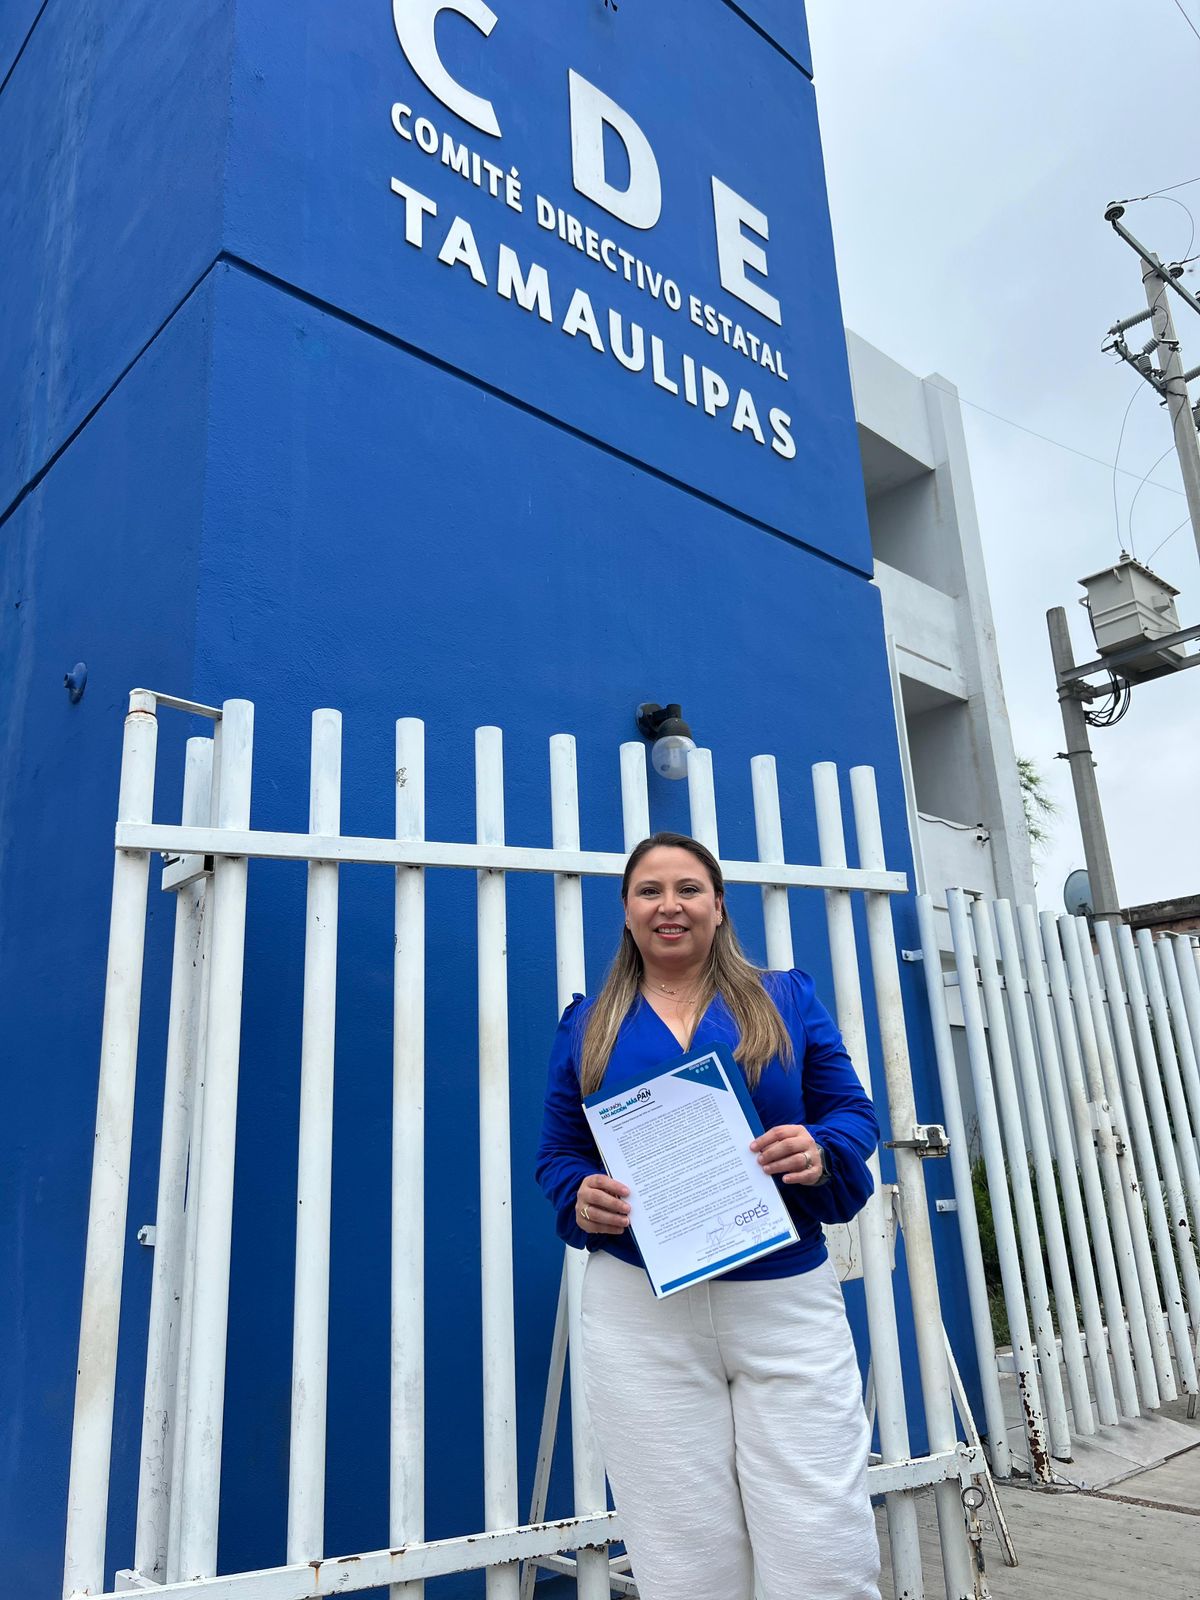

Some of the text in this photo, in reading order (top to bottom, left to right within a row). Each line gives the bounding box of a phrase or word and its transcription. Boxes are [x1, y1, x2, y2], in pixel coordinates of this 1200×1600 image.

[390, 176, 797, 459] TAMAULIPAS
[391, 102, 789, 381] COMITÉ DIRECTIVO ESTATAL
[637, 1089, 651, 1101] PAN
